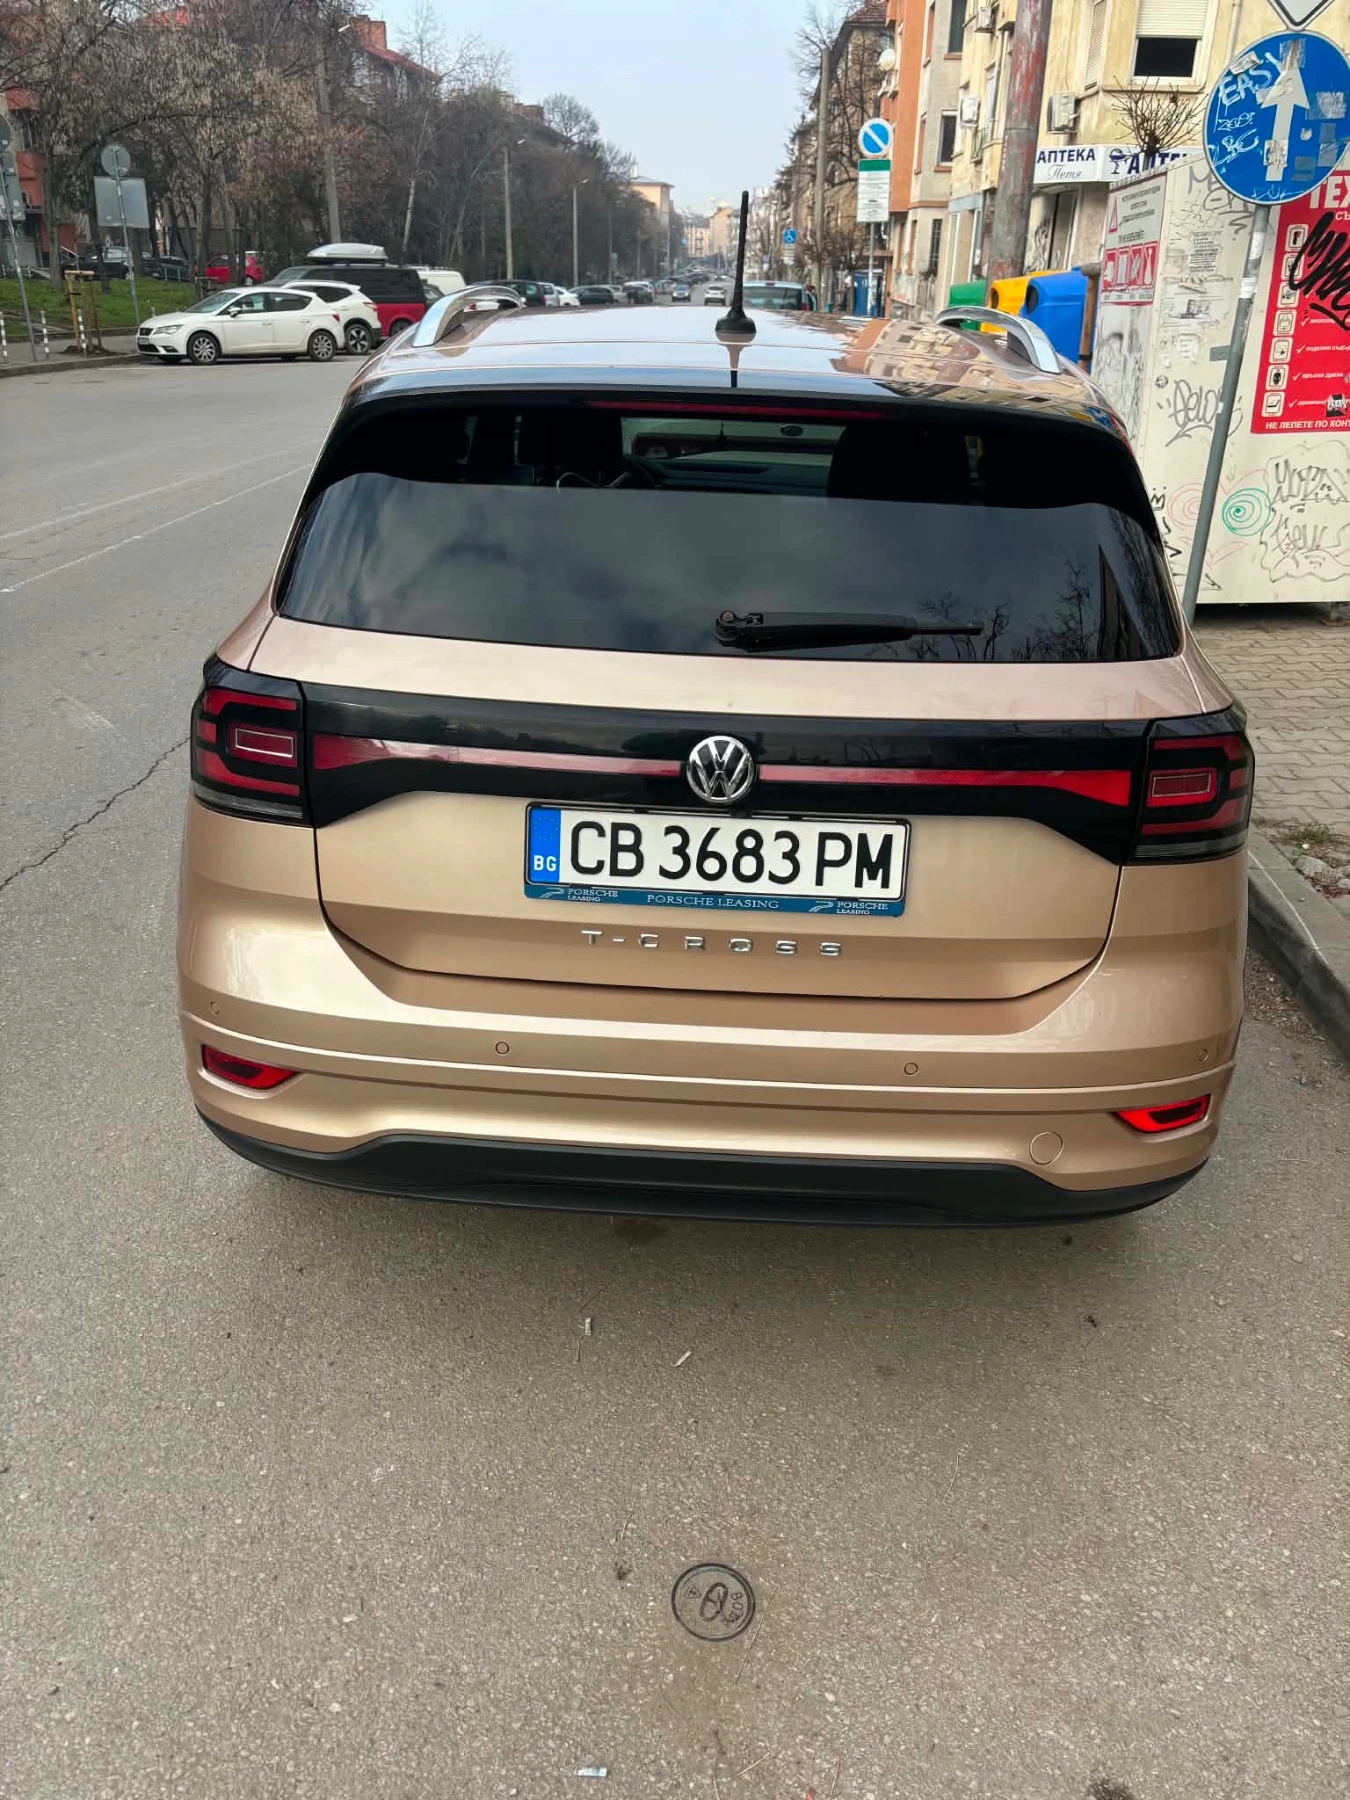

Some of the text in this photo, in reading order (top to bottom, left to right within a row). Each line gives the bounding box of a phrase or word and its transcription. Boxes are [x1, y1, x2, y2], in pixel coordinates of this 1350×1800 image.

[1037, 148, 1096, 164] АПТЕКА
[1048, 164, 1083, 179] Петя
[1265, 421, 1278, 429] НЕ
[1279, 420, 1313, 429] ЛЕПЕТЕ
[1315, 420, 1328, 429] ПО
[570, 820, 894, 889] CB 3683 PM
[533, 855, 557, 872] BG
[567, 887, 619, 898] PORSCHE
[647, 894, 779, 909] PORSCHE LEASING
[837, 901, 889, 911] PORSCHE
[580, 930, 841, 957] T-CROSS
